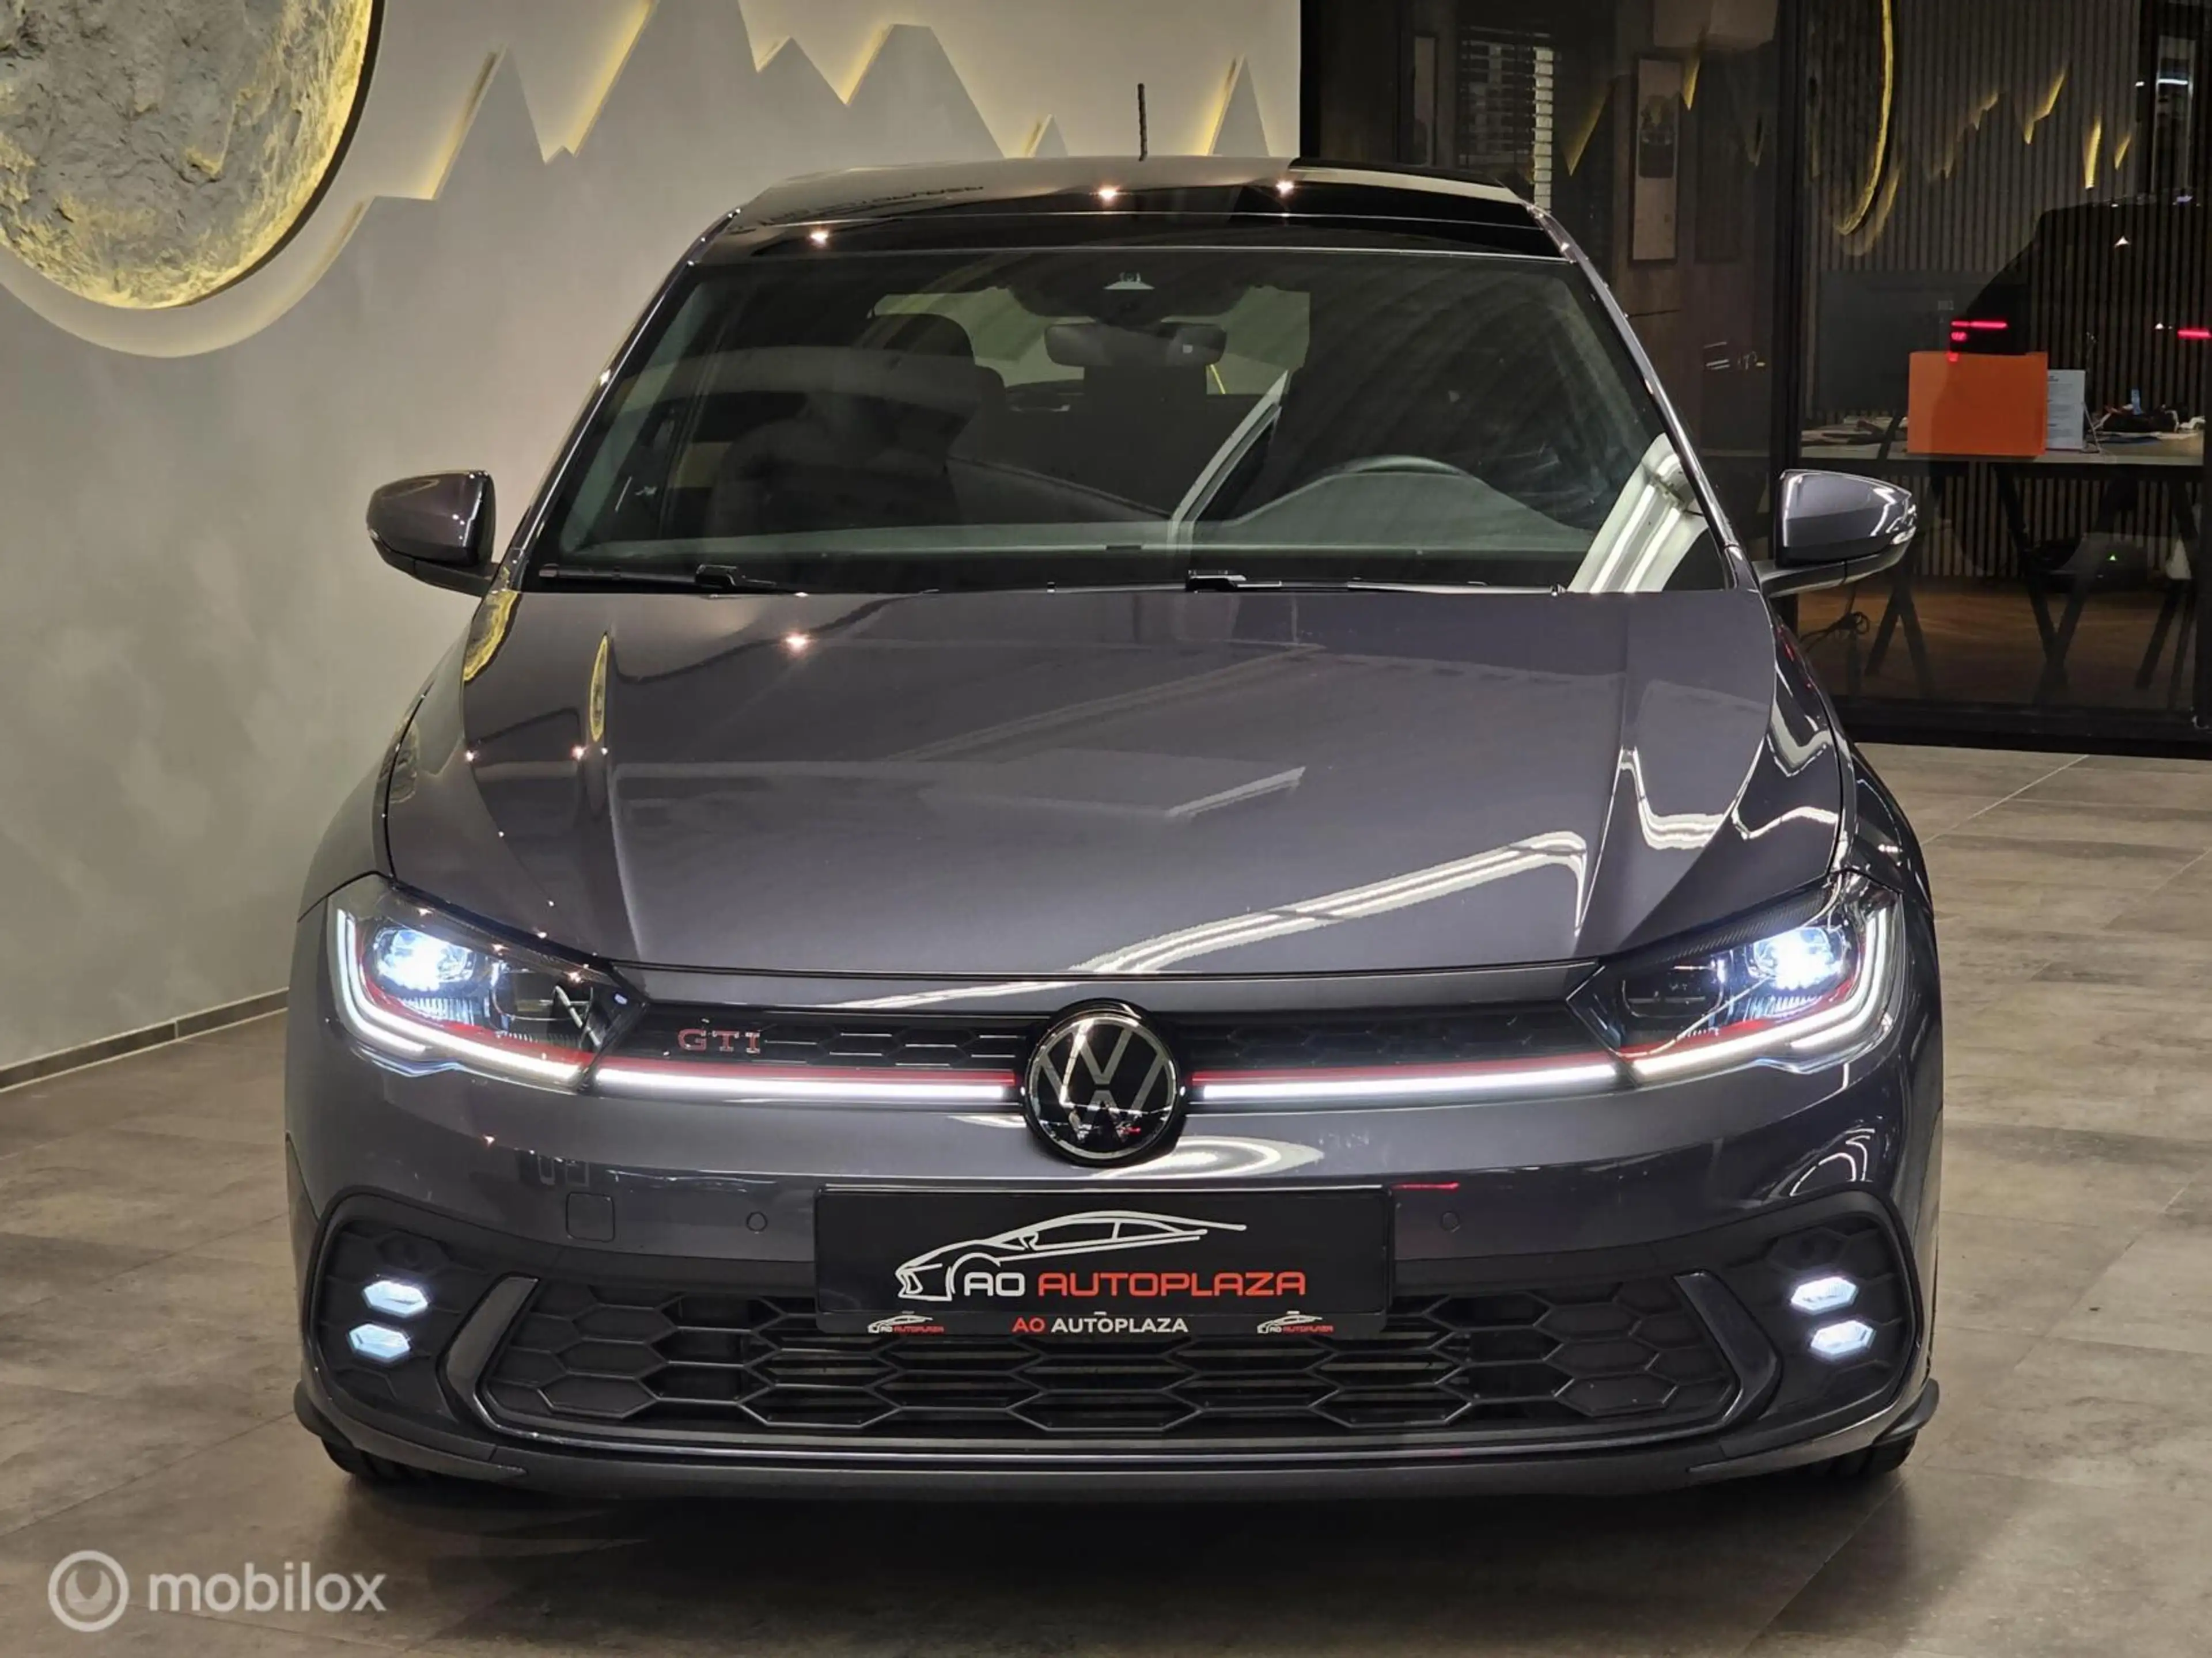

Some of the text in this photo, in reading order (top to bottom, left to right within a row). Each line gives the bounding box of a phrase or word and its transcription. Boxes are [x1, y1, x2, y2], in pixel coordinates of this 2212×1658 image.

[677, 1029, 761, 1054] GTI
[964, 1271, 1306, 1296] AO AUTOPLAZA
[1012, 1317, 1189, 1333] AO AUTOPLAZA
